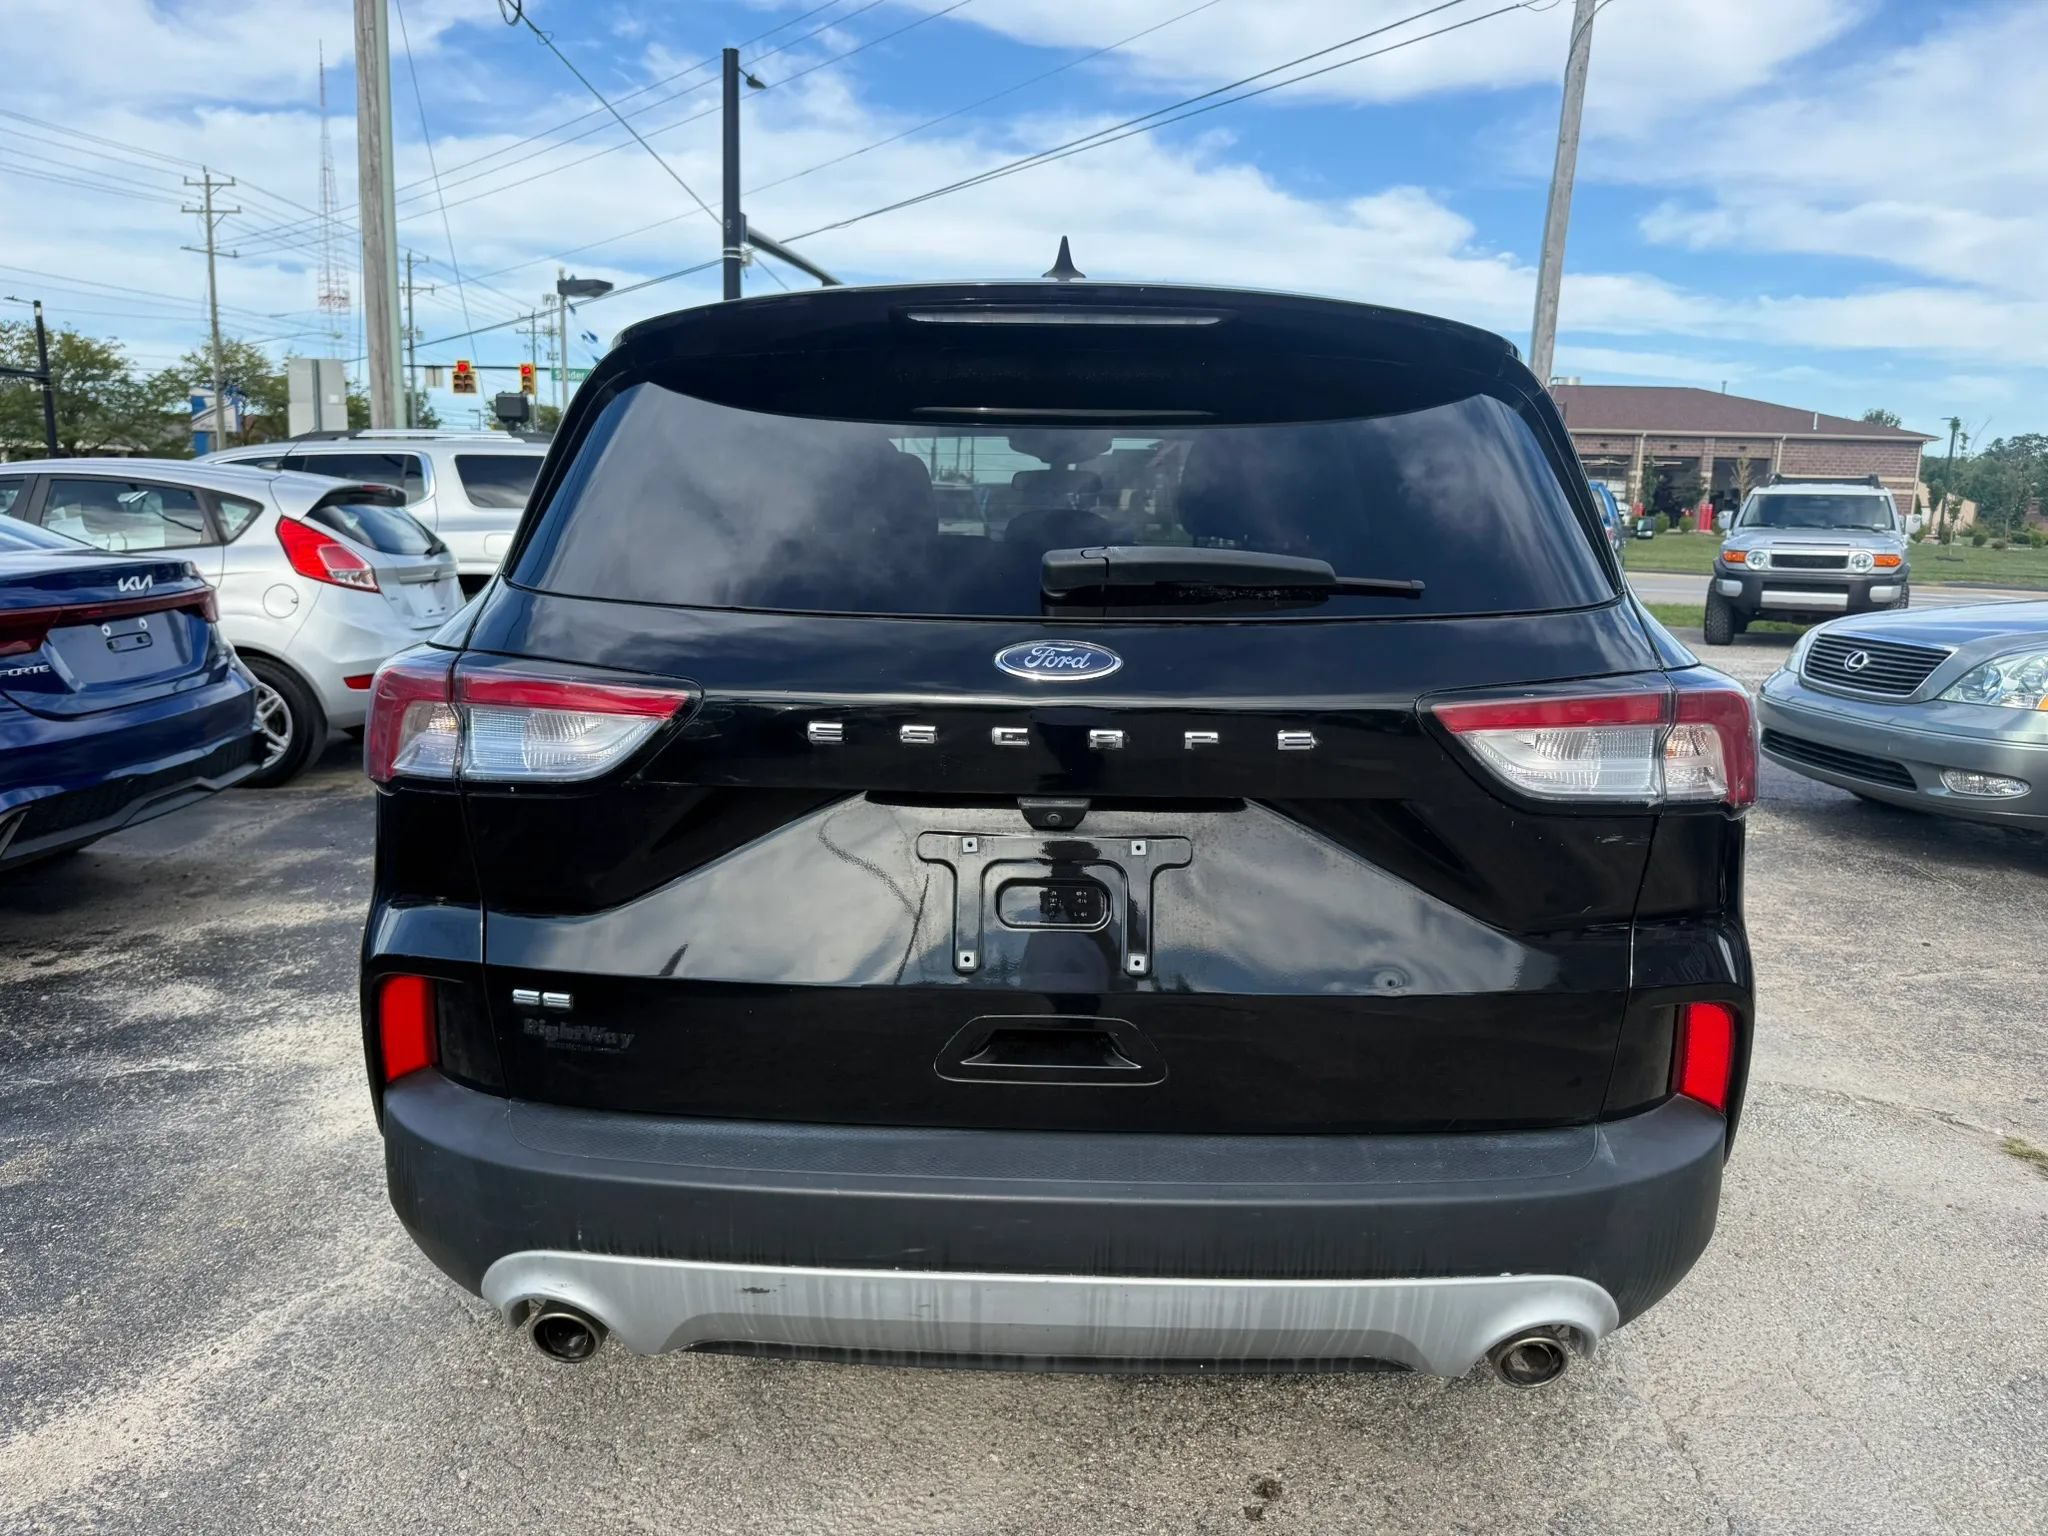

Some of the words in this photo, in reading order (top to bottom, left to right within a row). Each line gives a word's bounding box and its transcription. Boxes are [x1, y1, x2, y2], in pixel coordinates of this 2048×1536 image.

[118, 575, 153, 592] KIA
[1024, 646, 1092, 669] Ford
[0, 664, 50, 677] FORTE
[808, 720, 1315, 751] ESCAPE
[513, 989, 571, 1008] SE
